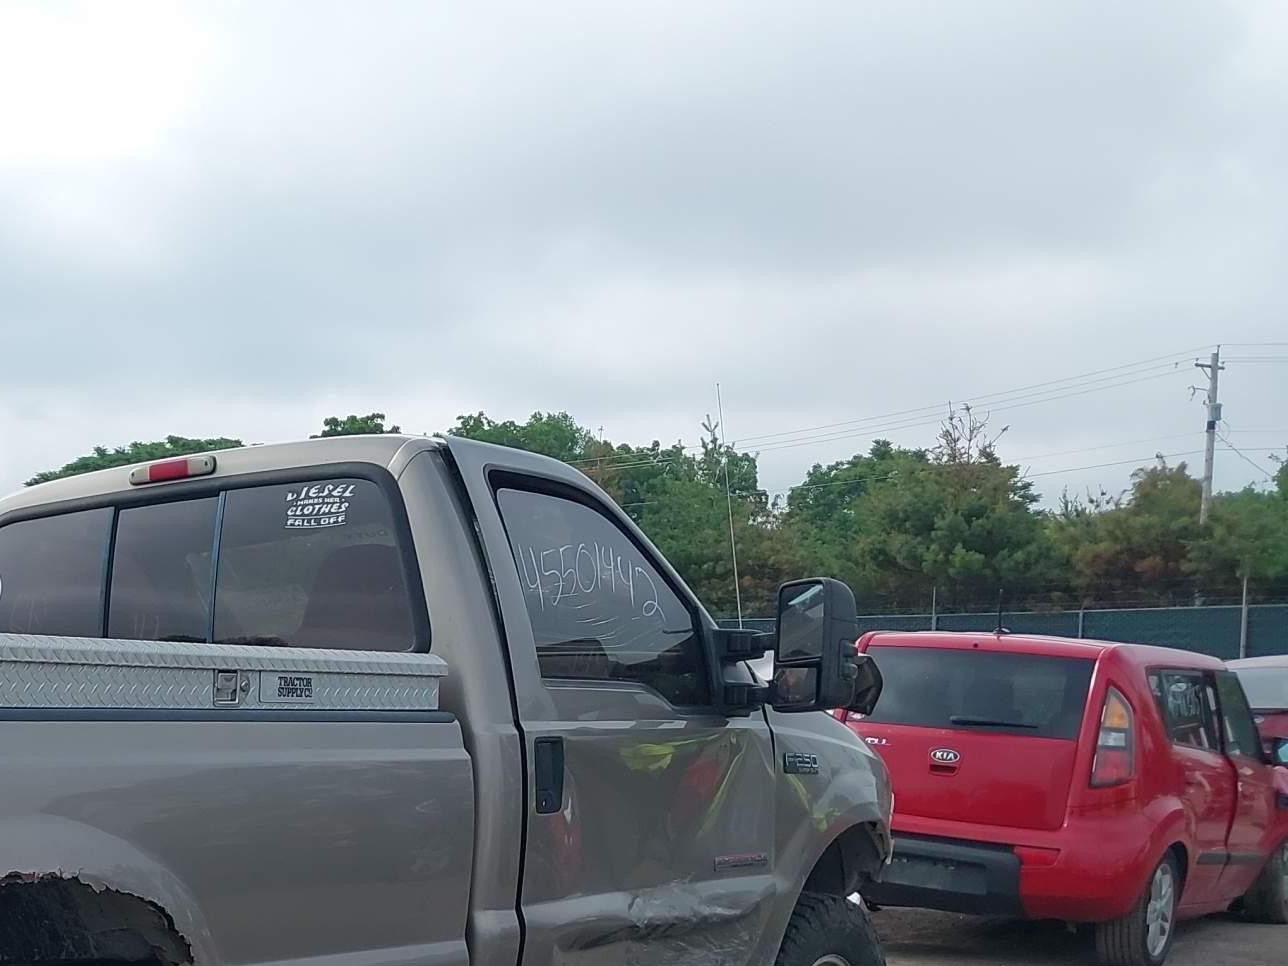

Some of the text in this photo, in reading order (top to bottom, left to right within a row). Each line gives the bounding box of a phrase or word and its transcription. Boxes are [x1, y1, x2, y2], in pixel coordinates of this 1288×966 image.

[287, 502, 349, 515] CLOTHES
[287, 515, 345, 526] FALL OFF
[517, 541, 666, 623] 45501442
[277, 676, 312, 688] TRACTOR
[277, 687, 304, 698] SUPPLY
[935, 751, 955, 760] KIA
